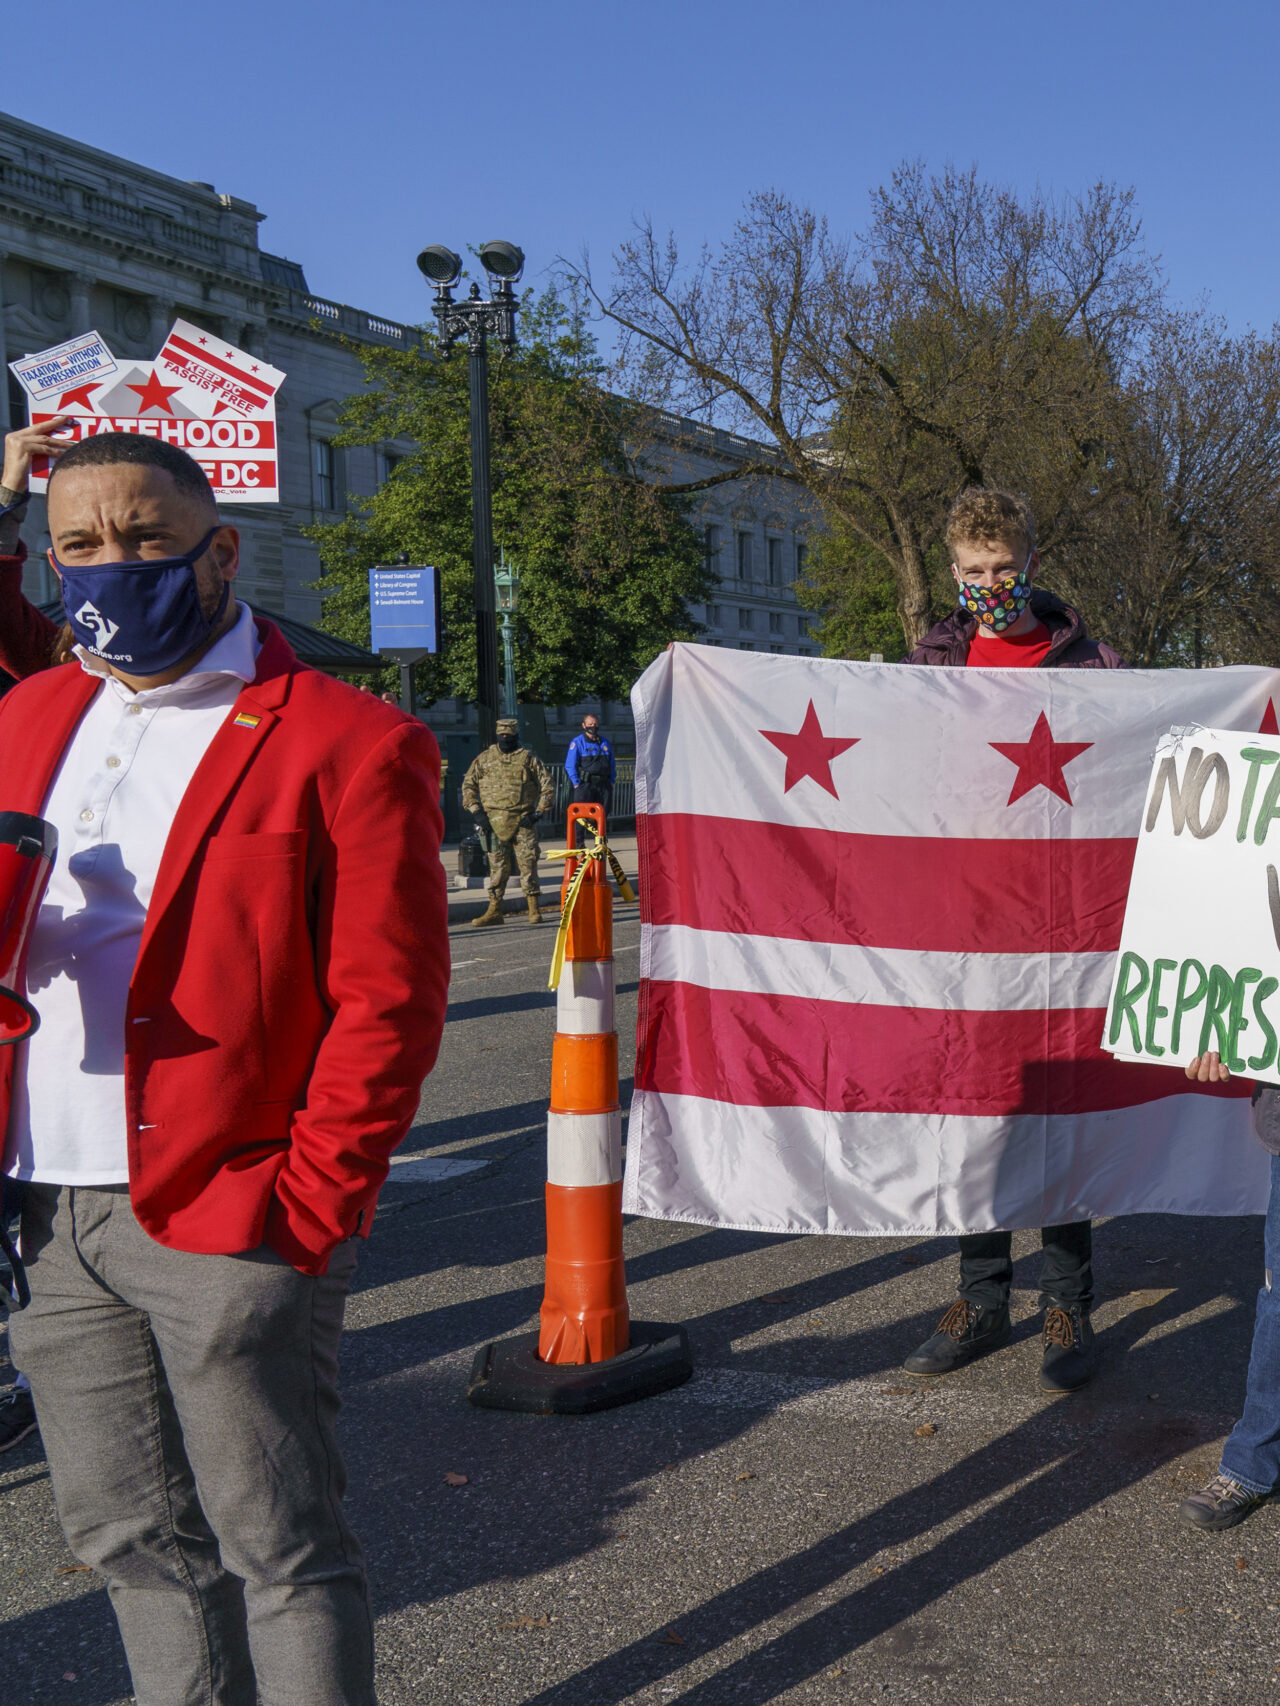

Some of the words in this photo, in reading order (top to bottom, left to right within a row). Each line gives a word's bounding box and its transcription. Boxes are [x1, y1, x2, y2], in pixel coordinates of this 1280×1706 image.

[21, 361, 62, 382] TAXATION
[66, 344, 104, 365] WITHOUT
[37, 358, 102, 389] REPRESENTATION
[184, 360, 222, 383] KEEP
[222, 380, 242, 395] DC
[163, 361, 219, 394] FASCIST
[220, 391, 255, 414] FREE
[221, 462, 260, 487] DC
[82, 611, 112, 634] 51
[1145, 746, 1230, 839] NO
